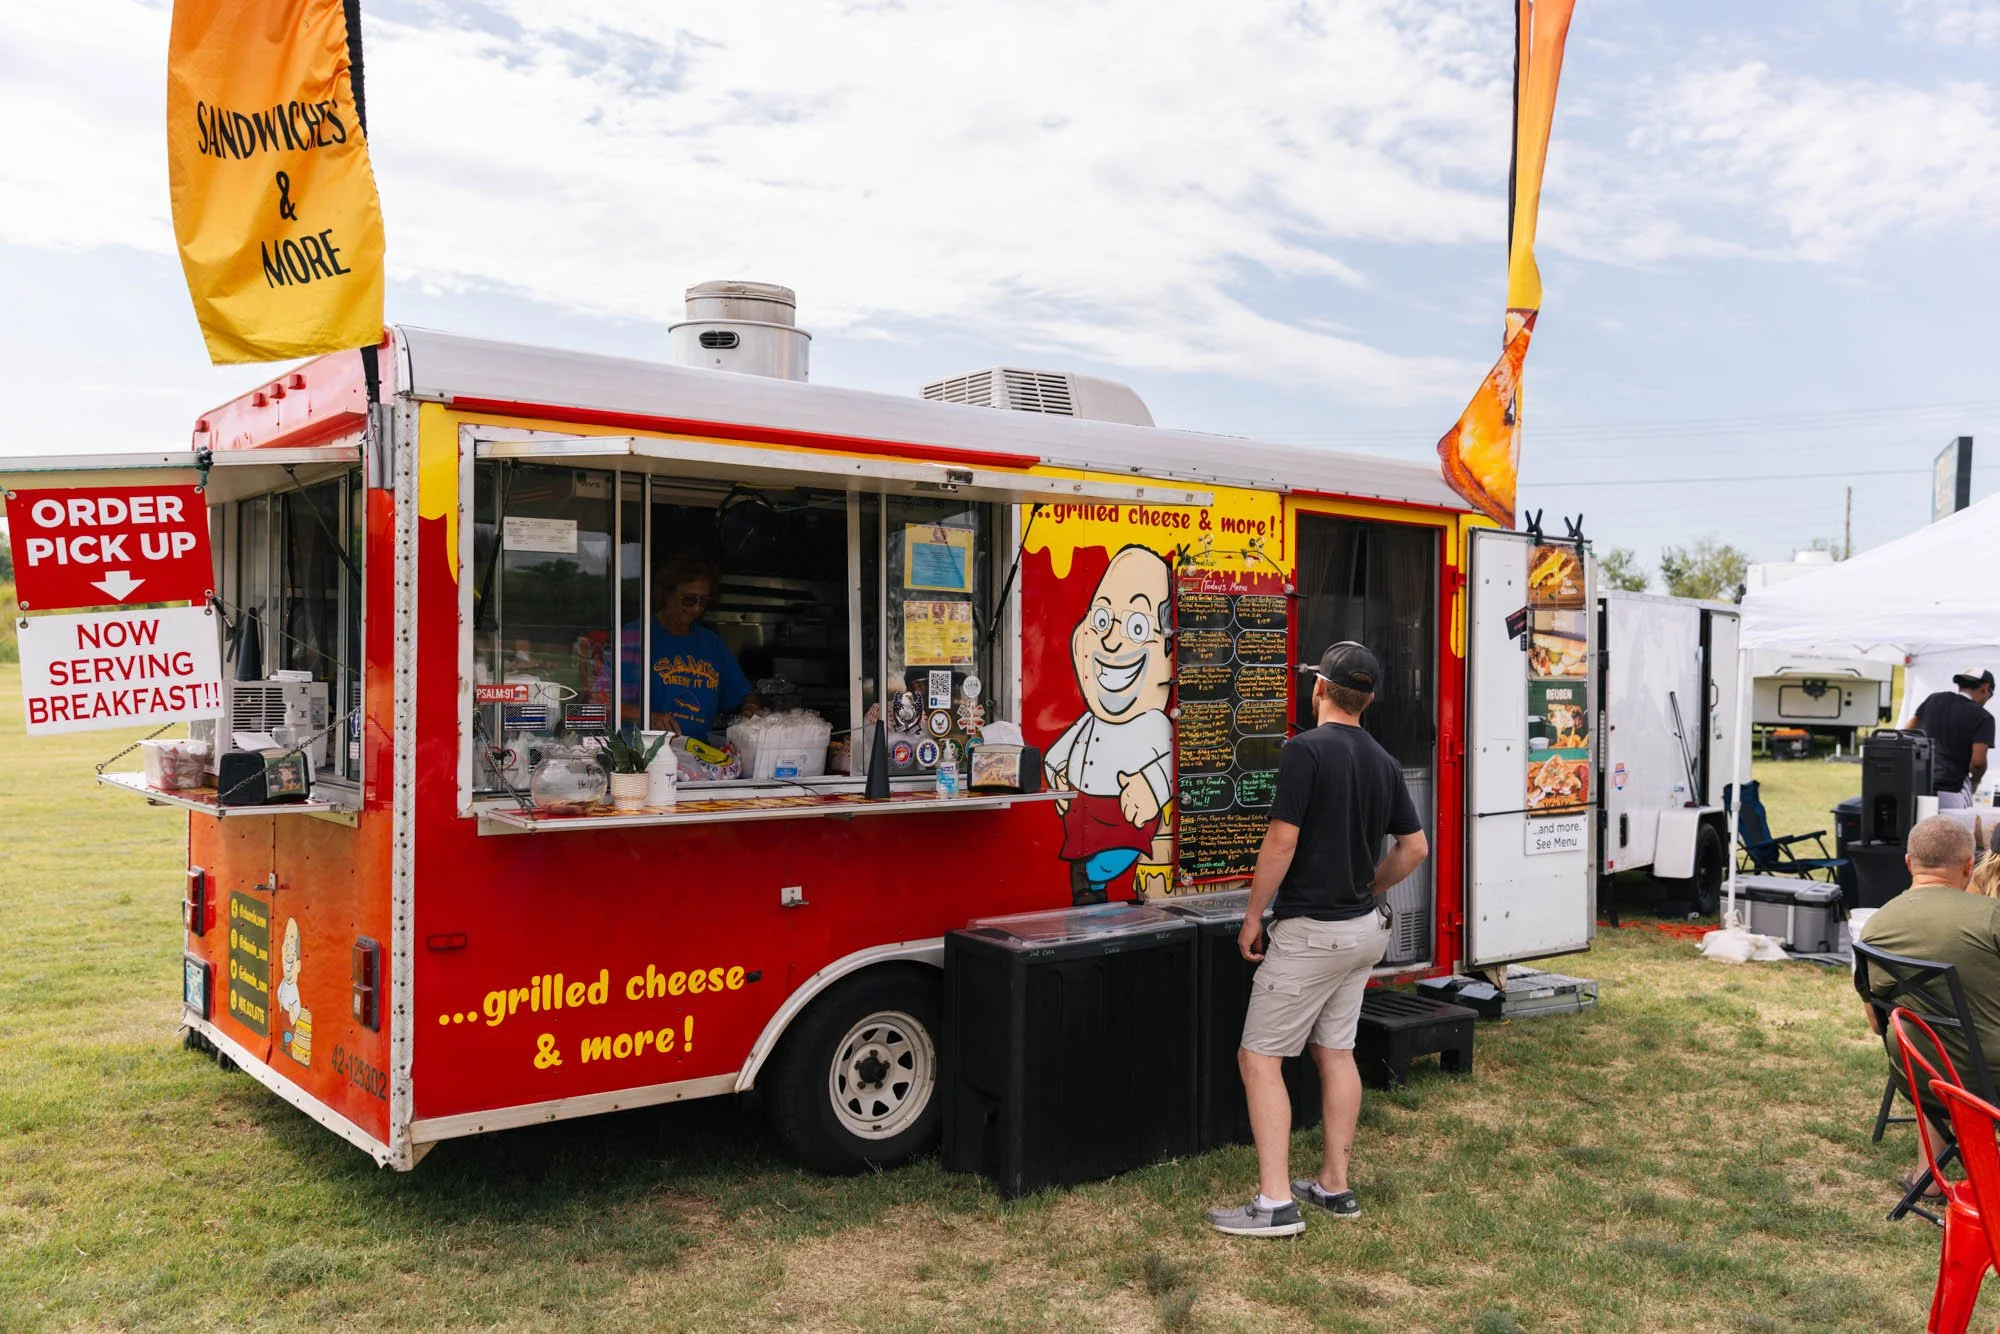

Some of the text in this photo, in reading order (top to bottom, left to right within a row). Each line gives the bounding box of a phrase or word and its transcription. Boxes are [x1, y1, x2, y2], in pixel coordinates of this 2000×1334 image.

[197, 100, 347, 159] SANDWICHES
[276, 171, 298, 220] &
[261, 229, 351, 288] MORE
[31, 495, 185, 528] ORDER
[1128, 504, 1191, 529] cheese
[1198, 508, 1213, 531] &
[25, 531, 197, 567] PICK UP
[1203, 580, 1248, 592] Today's Menu
[76, 619, 160, 650] NOW
[49, 651, 195, 686] SERVING
[28, 682, 221, 726] BREAKFAST!!
[476, 688, 514, 699] PSALM:91
[1545, 688, 1573, 700] REUBEN
[1536, 837, 1577, 850] See Menu
[625, 964, 745, 1000] cheese
[533, 1033, 563, 1069] &
[331, 1043, 387, 1101] 42-125302
